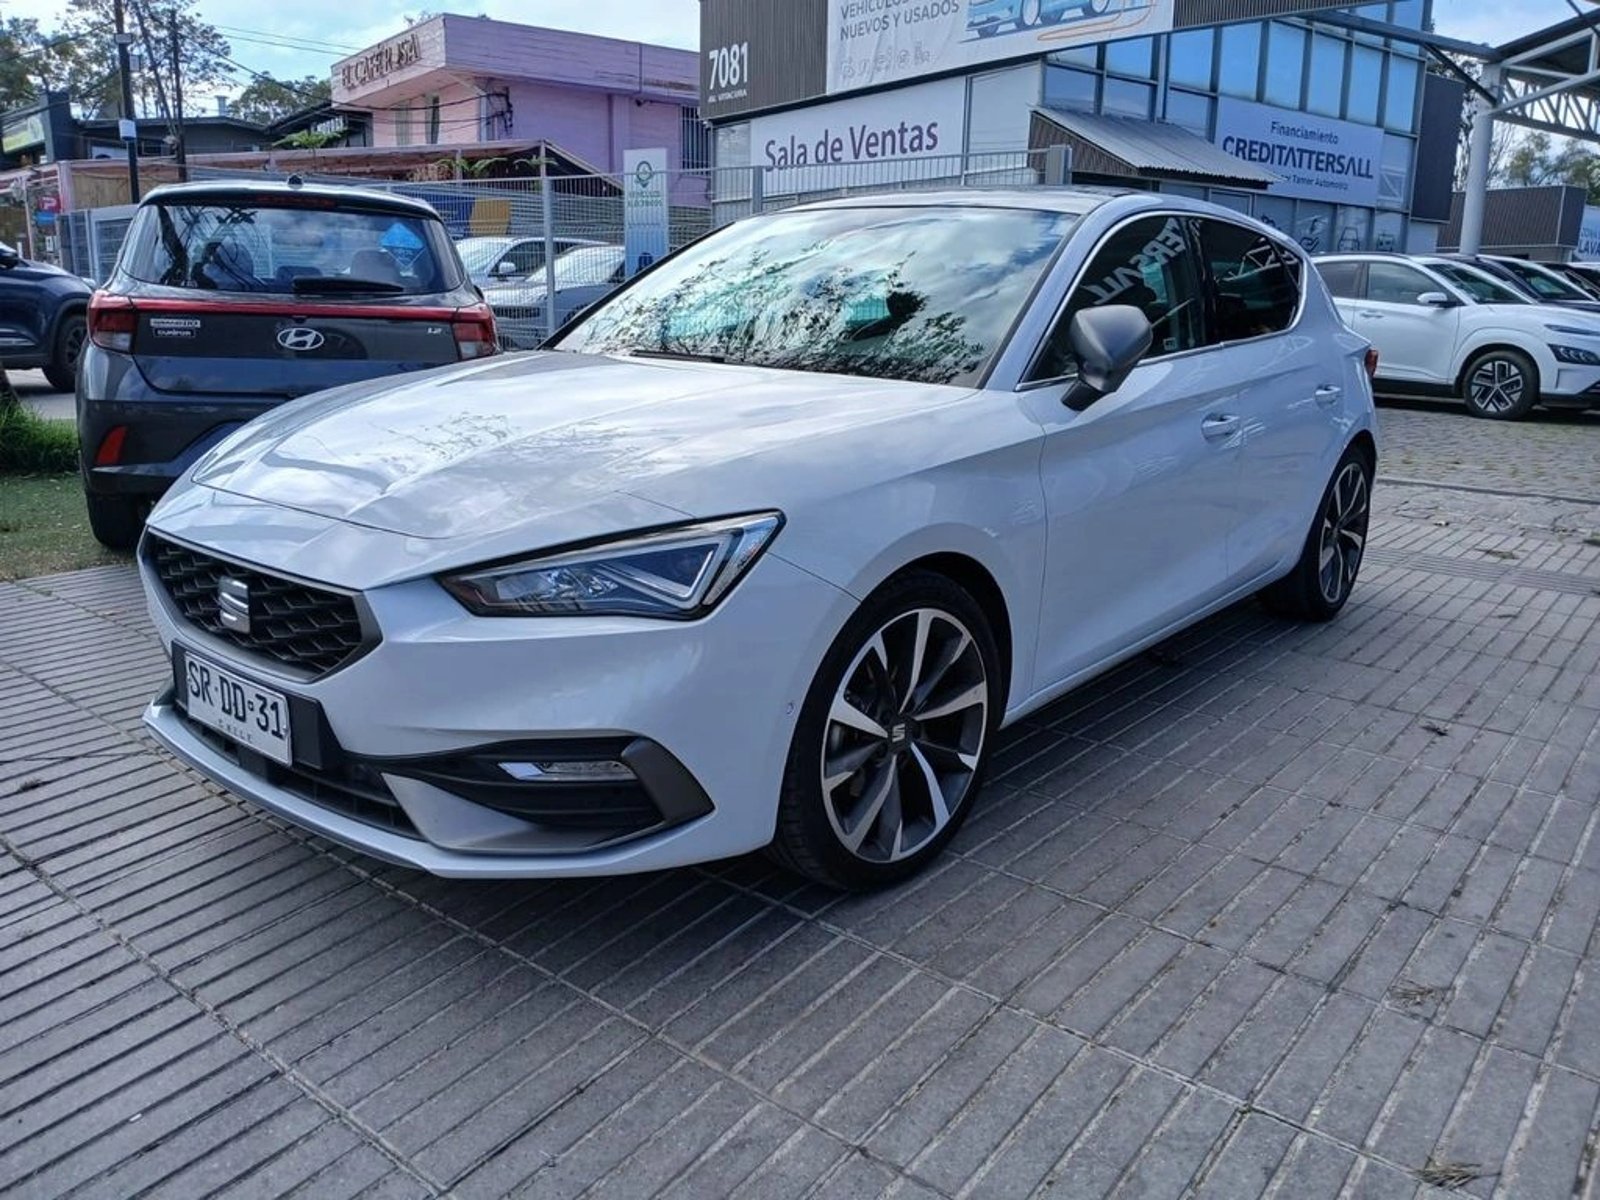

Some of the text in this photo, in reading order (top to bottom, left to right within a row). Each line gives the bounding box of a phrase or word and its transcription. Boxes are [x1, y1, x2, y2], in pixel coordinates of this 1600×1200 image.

[840, 0, 909, 20] VEHICUL
[840, 1, 960, 41] NUEVOS Y USADOS
[709, 42, 748, 90] 7081
[765, 121, 938, 172] Sala de Ventas
[1271, 120, 1339, 145] Financiamiento
[1222, 135, 1374, 180] CREDITATTERSALL
